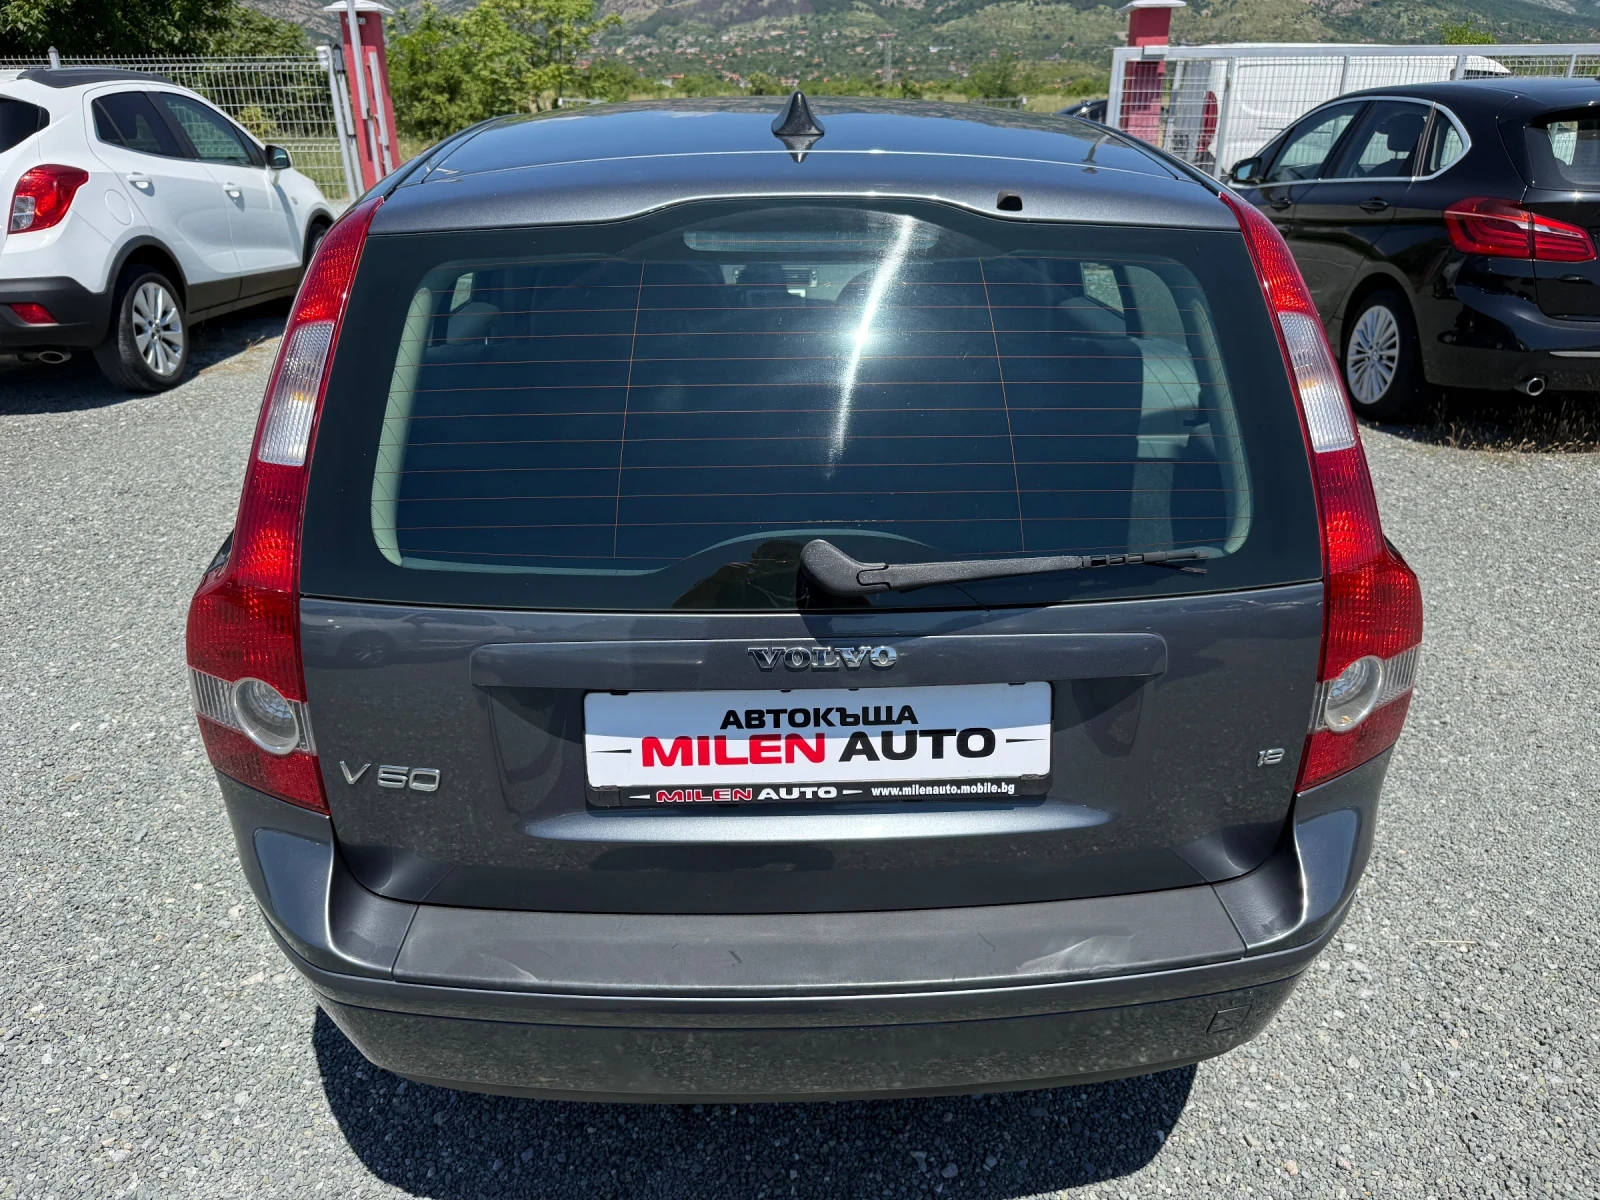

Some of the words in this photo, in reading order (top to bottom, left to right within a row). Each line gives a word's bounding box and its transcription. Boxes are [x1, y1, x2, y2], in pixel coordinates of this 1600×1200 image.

[748, 646, 898, 671] VOLVO
[720, 705, 919, 729] АВТОКЪЩА
[641, 733, 825, 767] MILEN
[839, 728, 996, 763] AUTO
[656, 788, 752, 803] MILEN
[757, 786, 837, 799] AUTO
[871, 782, 1016, 797] www.milenauto.mobile.bg
